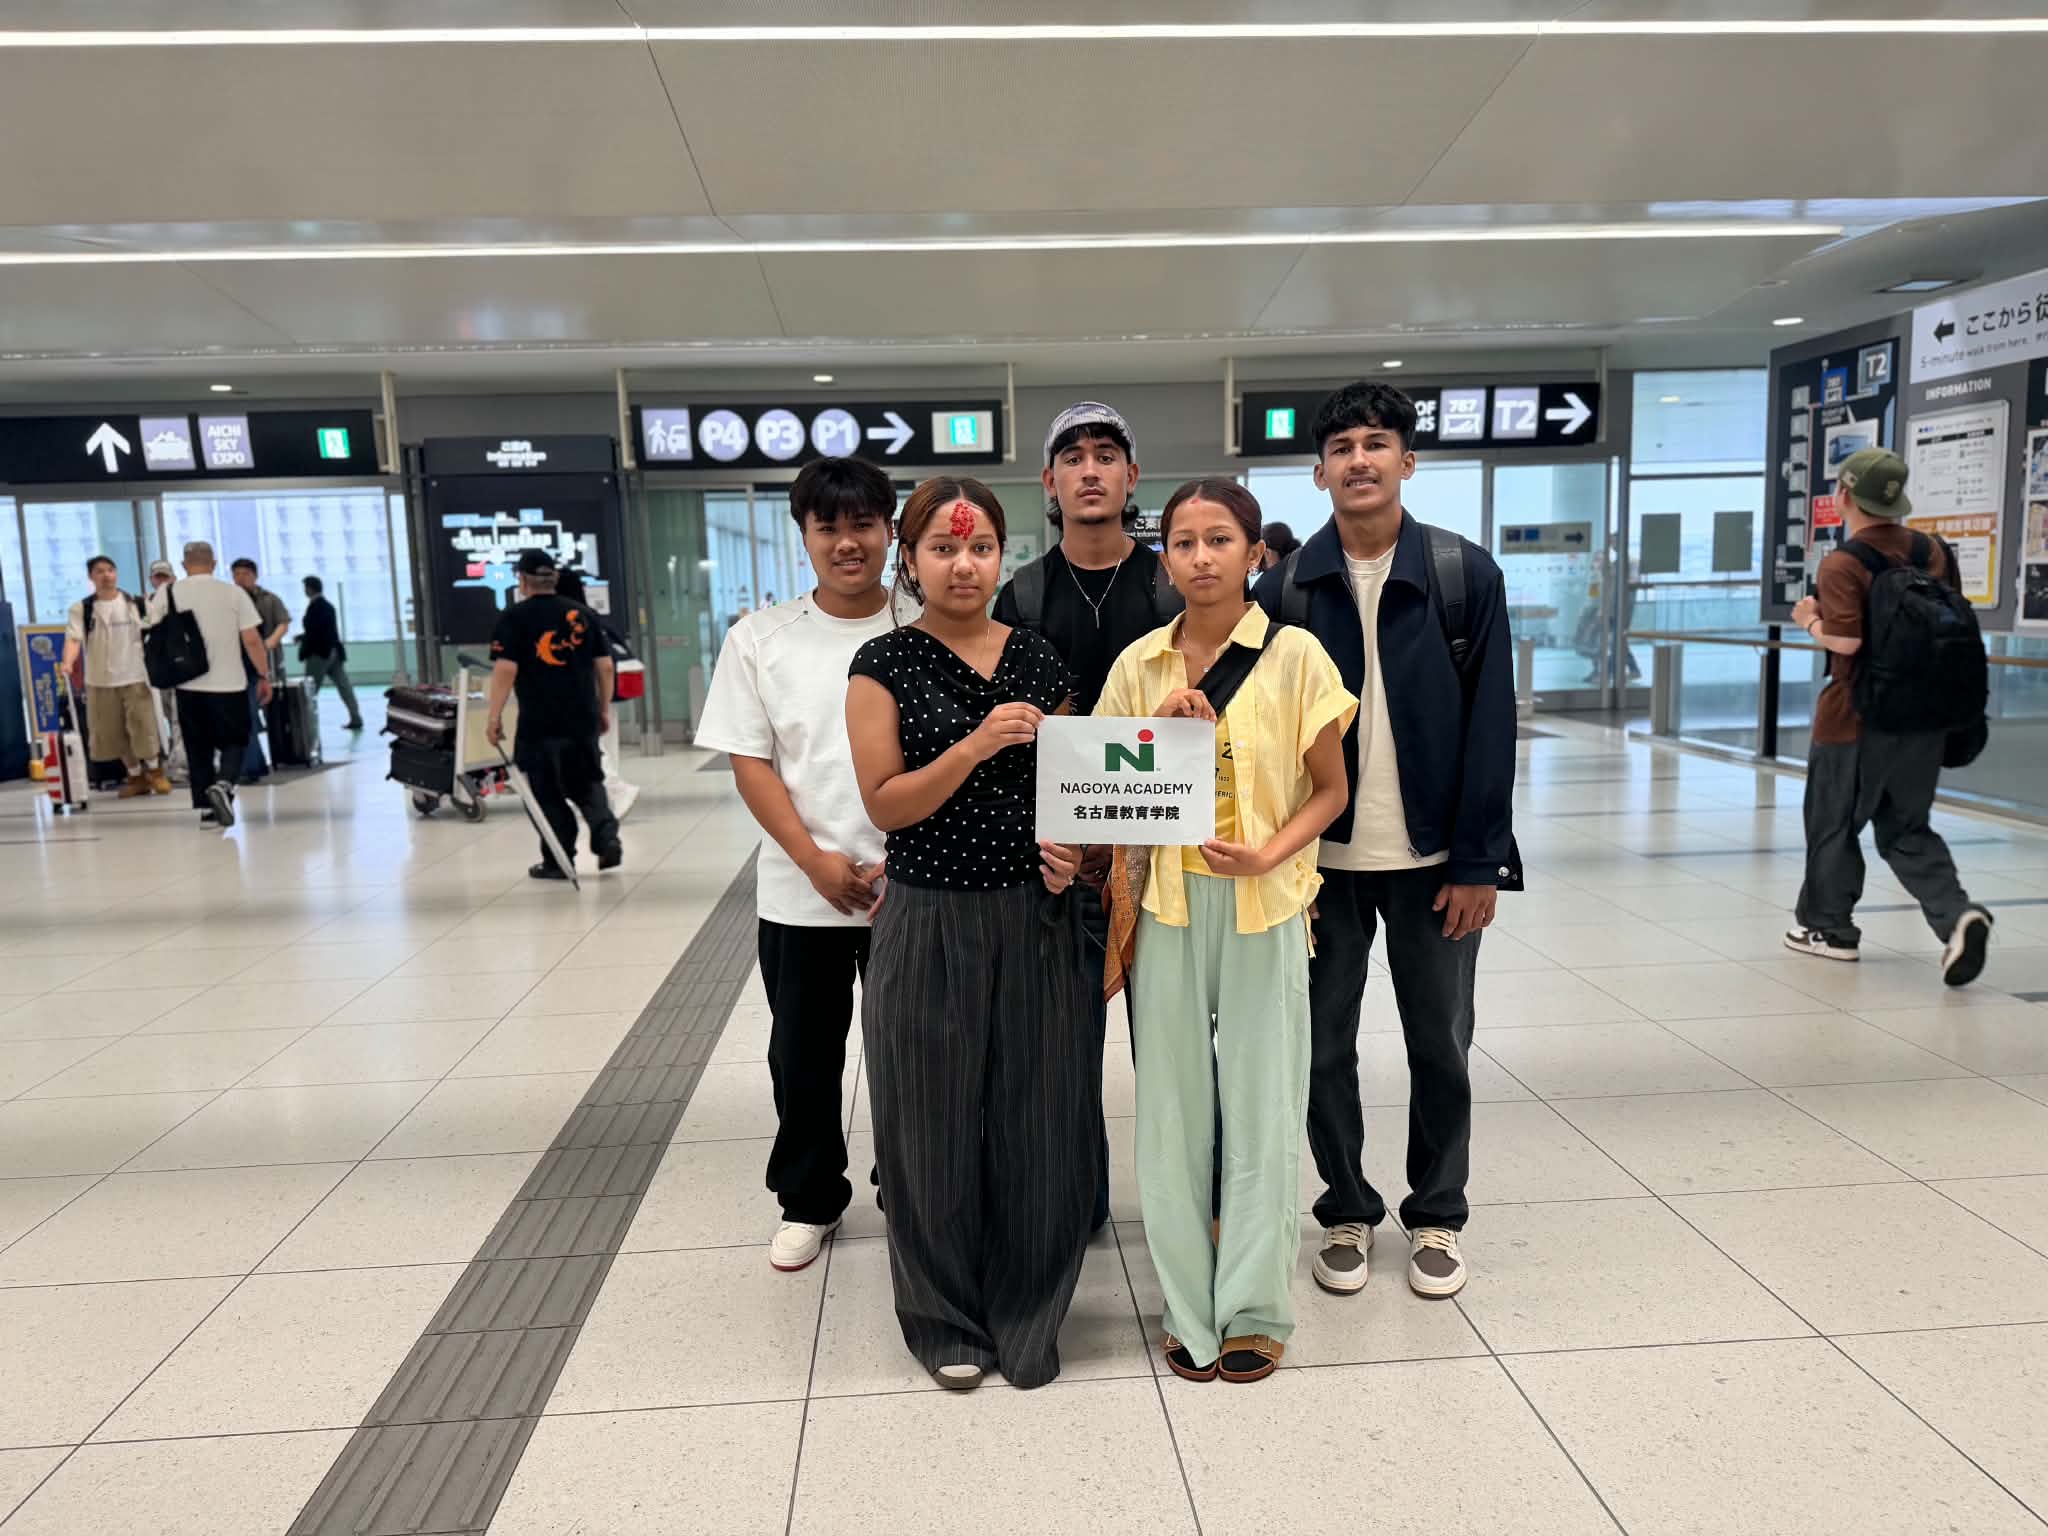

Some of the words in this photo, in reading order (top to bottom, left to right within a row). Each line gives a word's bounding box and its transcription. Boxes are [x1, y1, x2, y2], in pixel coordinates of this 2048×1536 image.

[1866, 352, 1887, 378] T2
[1925, 377, 1992, 400] INFORMATION
[1414, 400, 1436, 416] OF
[1495, 400, 1536, 431] T2
[207, 424, 242, 438] AICHI
[702, 420, 743, 451] P4
[758, 419, 799, 450] P3
[816, 418, 855, 450] P1
[214, 438, 238, 451] SKY
[211, 451, 245, 465] EXPO
[1060, 782, 1120, 794] NAGOYA
[1124, 783, 1193, 795] ACADEMY
[1073, 805, 1180, 820] 名古屋教育学院
